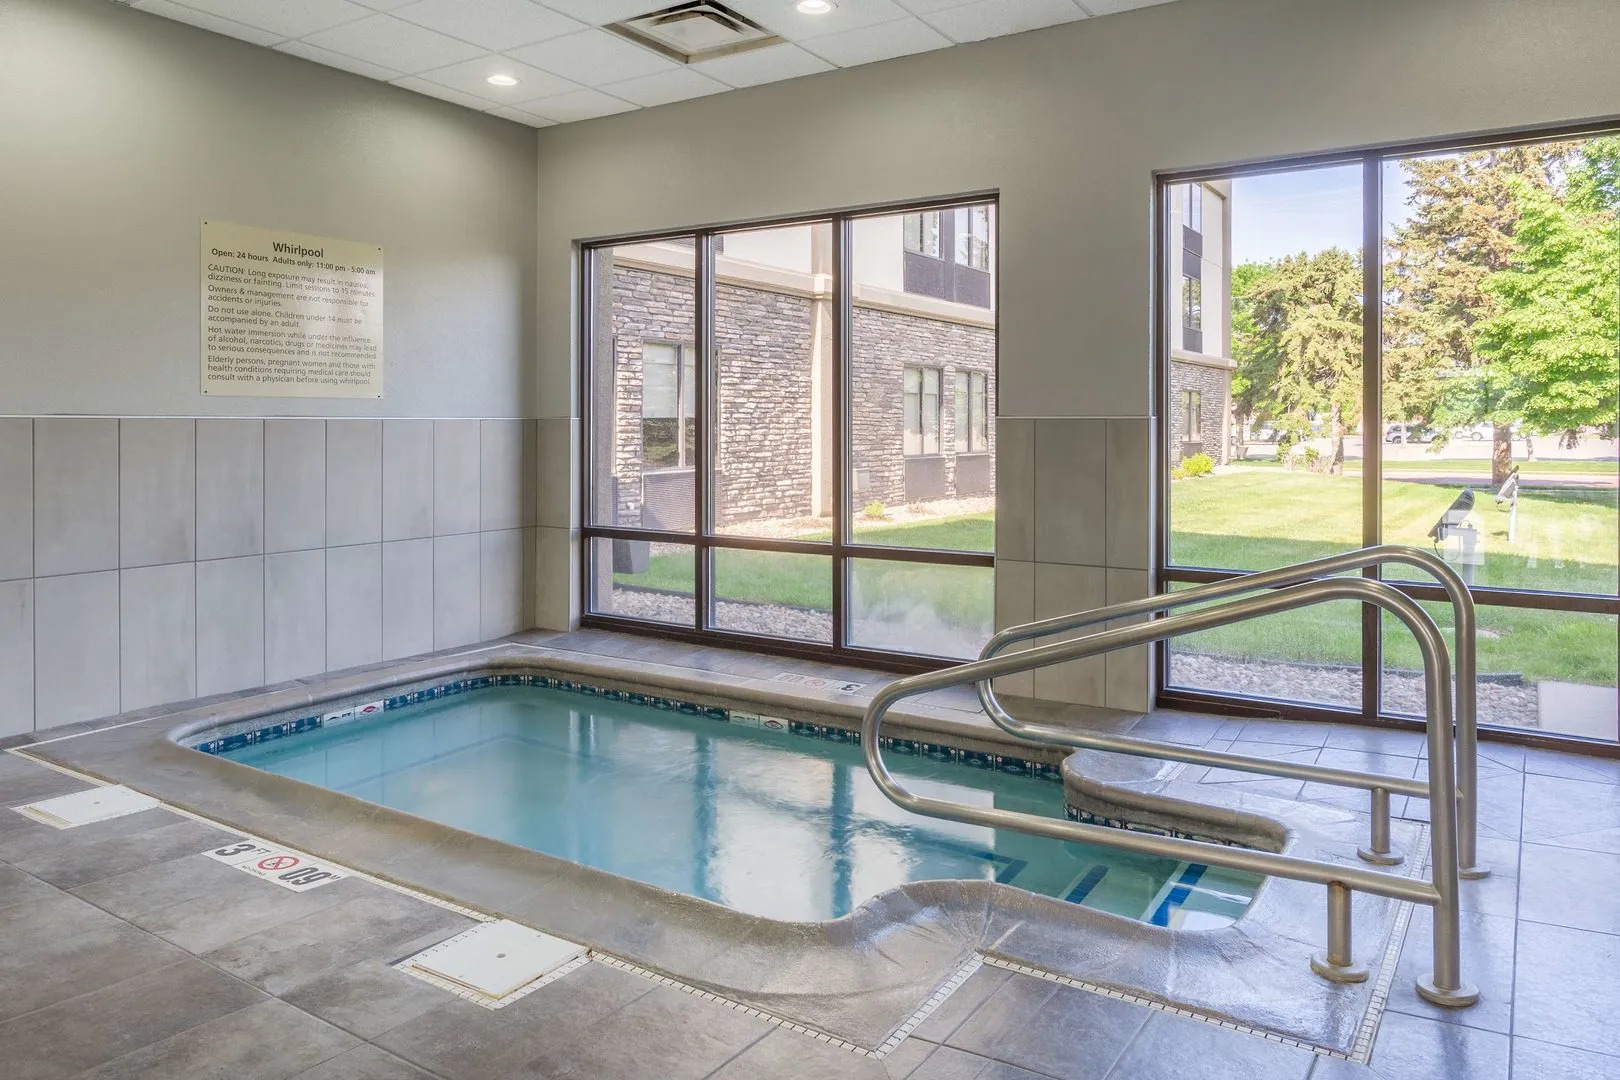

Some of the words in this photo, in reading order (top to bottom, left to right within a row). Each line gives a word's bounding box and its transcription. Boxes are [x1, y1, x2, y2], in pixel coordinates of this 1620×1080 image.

[273, 241, 324, 258] Whirlpool
[212, 248, 235, 257] Open:
[248, 253, 268, 262] hours
[273, 256, 295, 265] Adults
[297, 260, 314, 269] only:
[316, 262, 333, 270] 11:00
[208, 264, 245, 275] CAUTION:
[248, 269, 266, 279] Long
[268, 272, 299, 281] exposure
[208, 273, 241, 283] dizziness
[208, 285, 237, 294] Owners
[247, 290, 294, 300] management
[323, 298, 358, 306] responsible
[208, 295, 242, 303] accidents
[275, 311, 304, 320] Children
[208, 316, 257, 324] accompanied
[260, 318, 268, 327] by
[249, 329, 285, 337] immersion
[219, 336, 248, 345] alcohol,
[286, 340, 304, 348] drugs
[208, 355, 234, 364] Elderly
[236, 358, 265, 366] persons,
[274, 368, 305, 376] requiring
[215, 844, 256, 856] 3
[251, 847, 272, 855] FT
